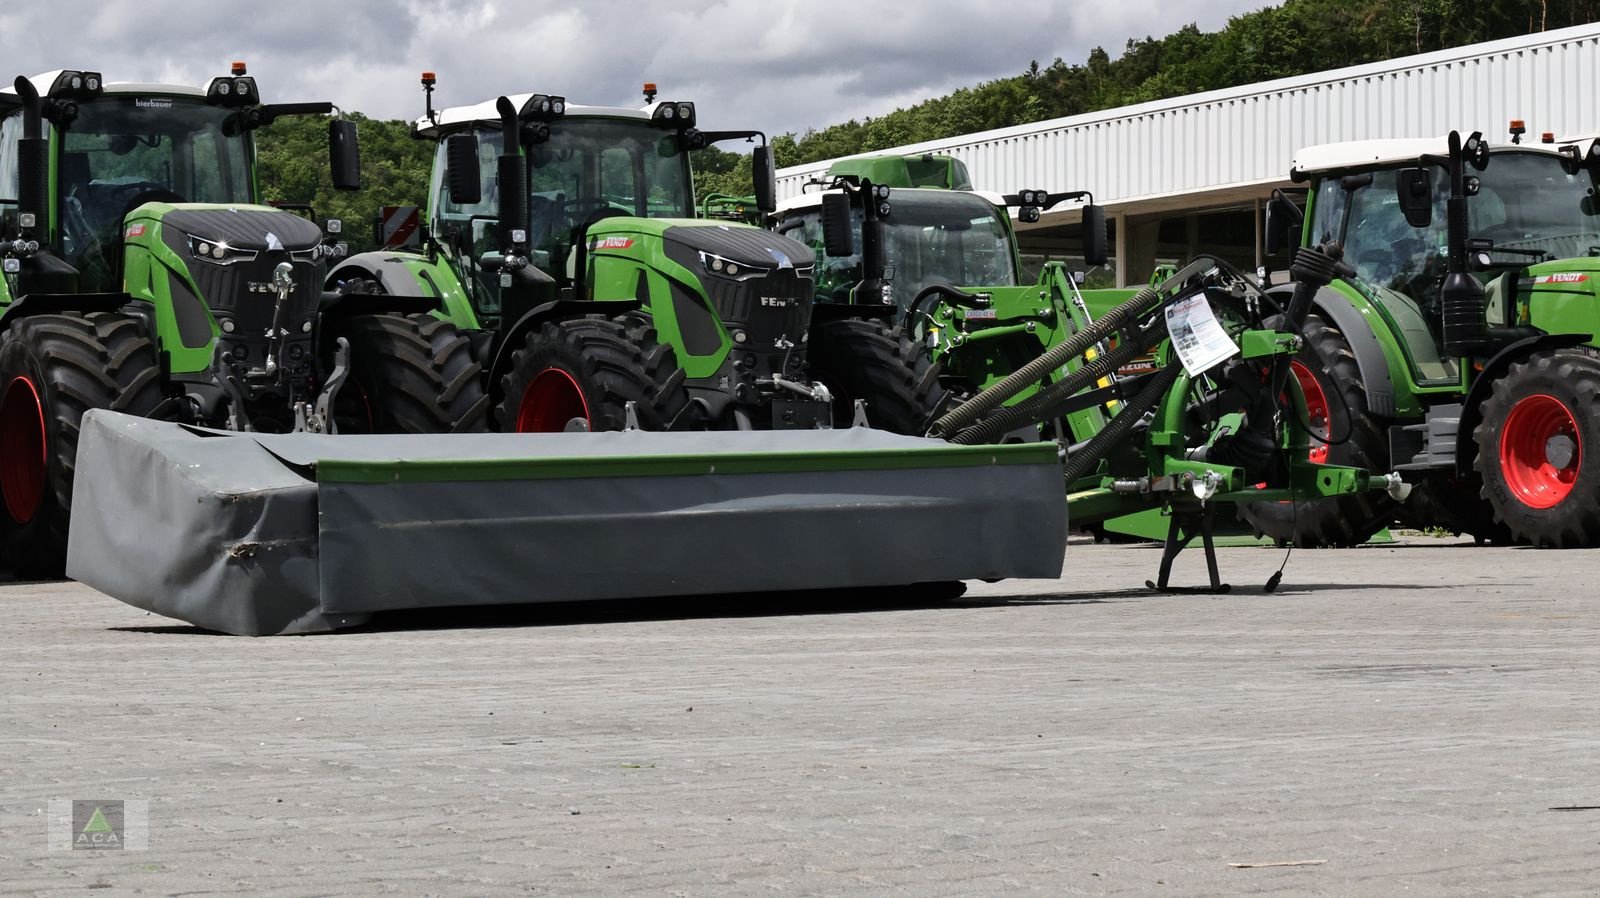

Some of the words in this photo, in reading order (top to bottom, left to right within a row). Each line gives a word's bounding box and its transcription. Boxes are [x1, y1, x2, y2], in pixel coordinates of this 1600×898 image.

[135, 98, 172, 108] bierbauer
[606, 236, 628, 247] FENDT
[1552, 272, 1583, 282] FENDT
[248, 281, 298, 293] FENT
